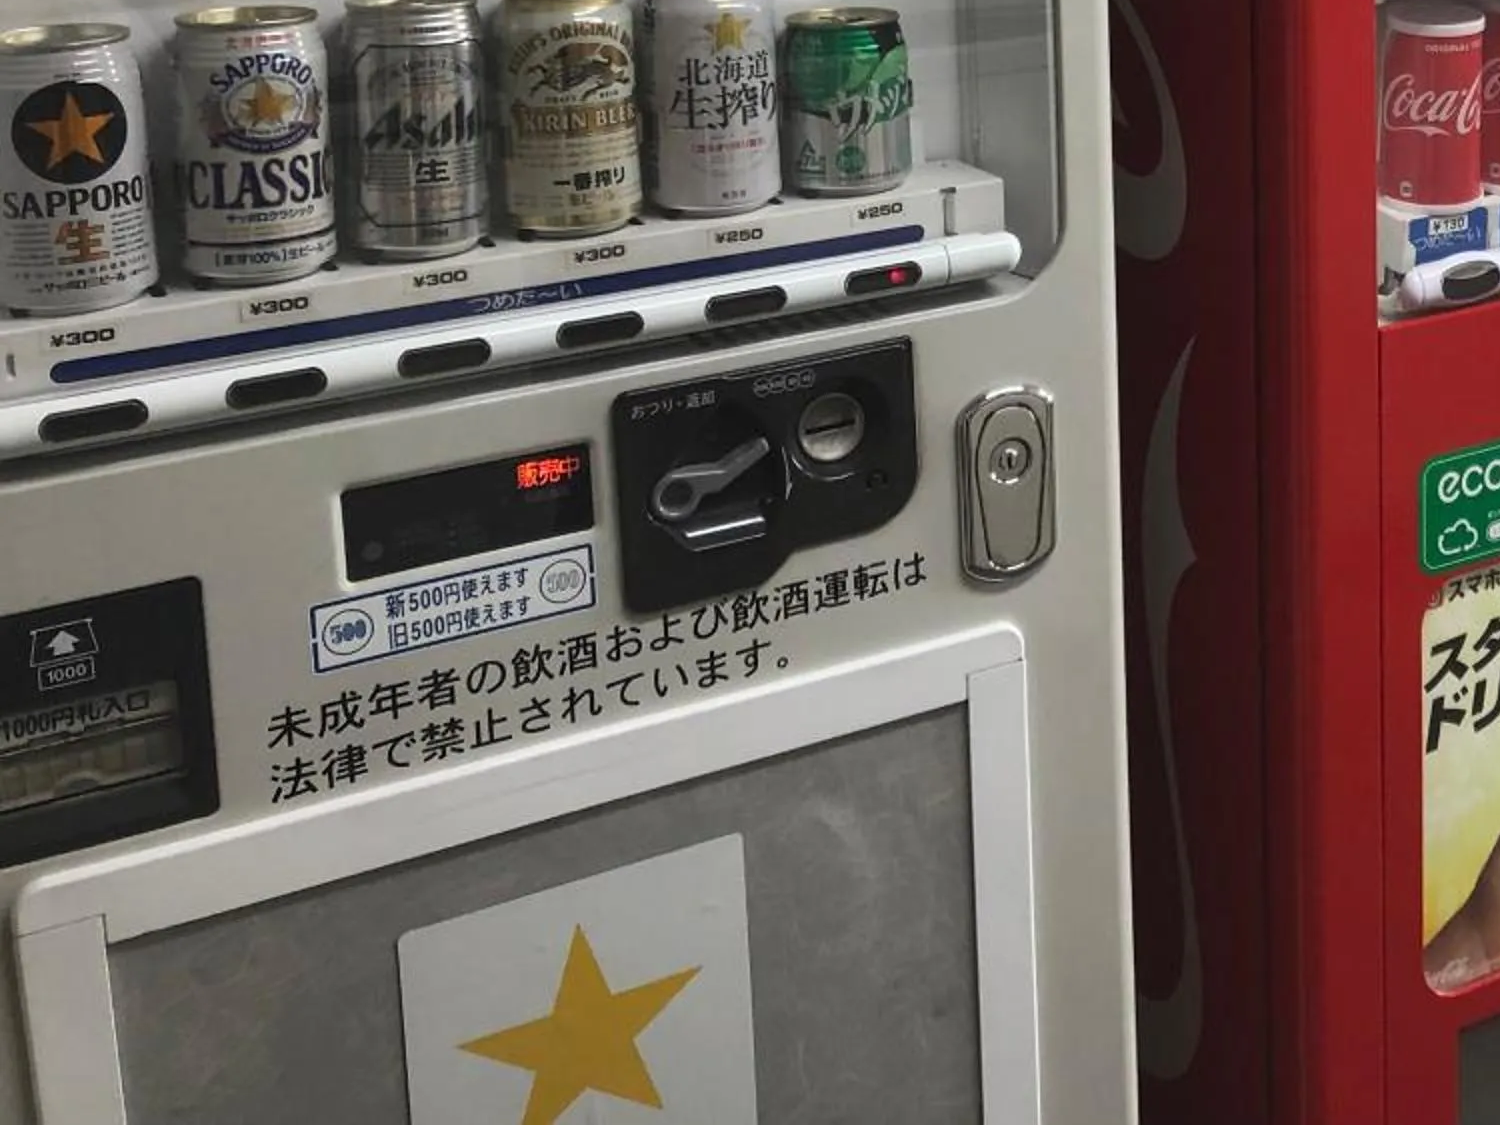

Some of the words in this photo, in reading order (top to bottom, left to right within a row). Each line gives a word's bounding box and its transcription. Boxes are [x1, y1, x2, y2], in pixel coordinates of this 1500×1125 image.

[209, 52, 313, 92] SAPPORO
[680, 50, 770, 87] 北海道
[520, 108, 590, 133] KIRIN
[667, 80, 780, 132] 生搾り
[415, 159, 451, 185] 生
[552, 165, 627, 192] 一番搾り
[2, 173, 146, 222] SAPPORO
[857, 201, 904, 221] ¥250
[53, 219, 110, 267] 生
[573, 243, 627, 261] ¥300
[714, 227, 764, 245] ¥250
[411, 269, 469, 289] ¥300
[248, 296, 310, 317] ¥300
[49, 327, 116, 349] ¥300
[629, 388, 717, 422] おつり・返却
[515, 455, 582, 490] 販売中
[383, 566, 530, 620] 新500円使えます
[328, 616, 368, 644] 500
[386, 594, 532, 650] 旧500円使えます
[266, 550, 929, 751] 未成年者の飲酒および飲酒運転は
[45, 661, 88, 685] 1000
[1, 690, 151, 744] 1000円札入口
[268, 635, 795, 805] 法律で禁止されています。
